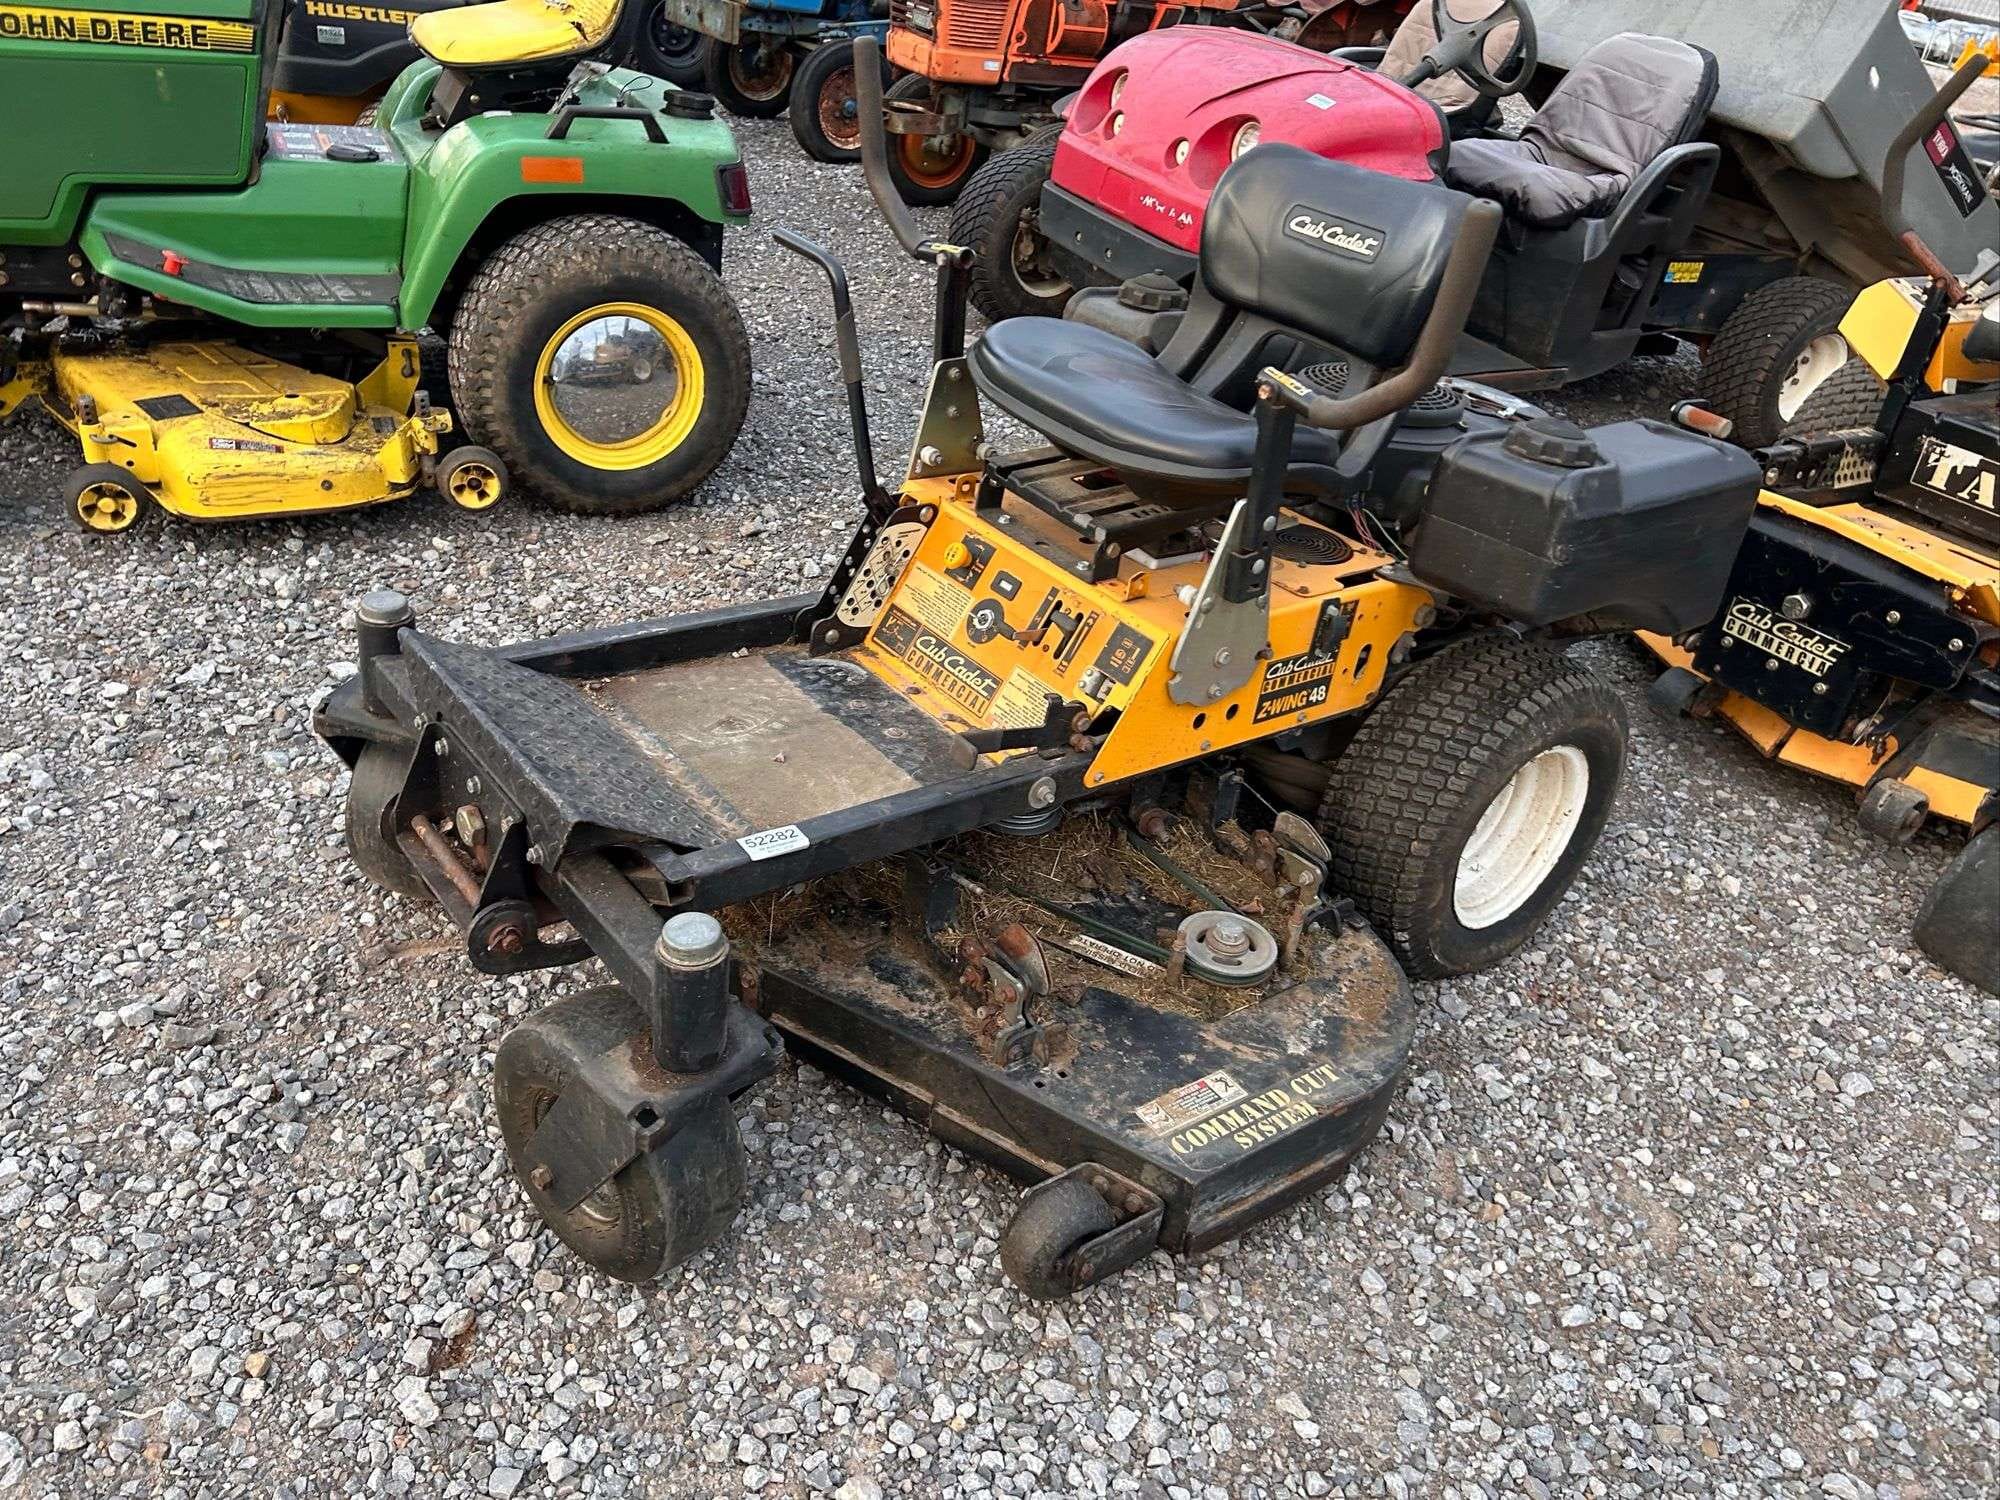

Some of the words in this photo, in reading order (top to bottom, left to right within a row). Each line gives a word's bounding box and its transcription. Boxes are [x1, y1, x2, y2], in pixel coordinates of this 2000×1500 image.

[0, 12, 79, 40] OHN
[89, 17, 210, 49] DEERE
[1933, 129, 1949, 158] TORO
[1289, 215, 1326, 239] Cub
[1322, 226, 1379, 256] Cadet
[1926, 445, 1996, 509] TA
[1725, 617, 1829, 676] COMMERCIA
[1731, 603, 1772, 630] Cub
[1771, 622, 1845, 662] Cadet
[906, 649, 987, 715] COMMERCIAL
[915, 635, 946, 664] Cub
[943, 655, 998, 697] Cadet
[1263, 662, 1335, 693] COMMERCIAL
[1266, 659, 1294, 679] Cub
[1256, 690, 1308, 719] Z-WING
[1309, 685, 1327, 703] 48
[745, 829, 798, 848] 52282
[1171, 1088, 1291, 1154] COMMAND
[1290, 1064, 1340, 1096] CUT
[1234, 1101, 1318, 1149] SYSTEM
